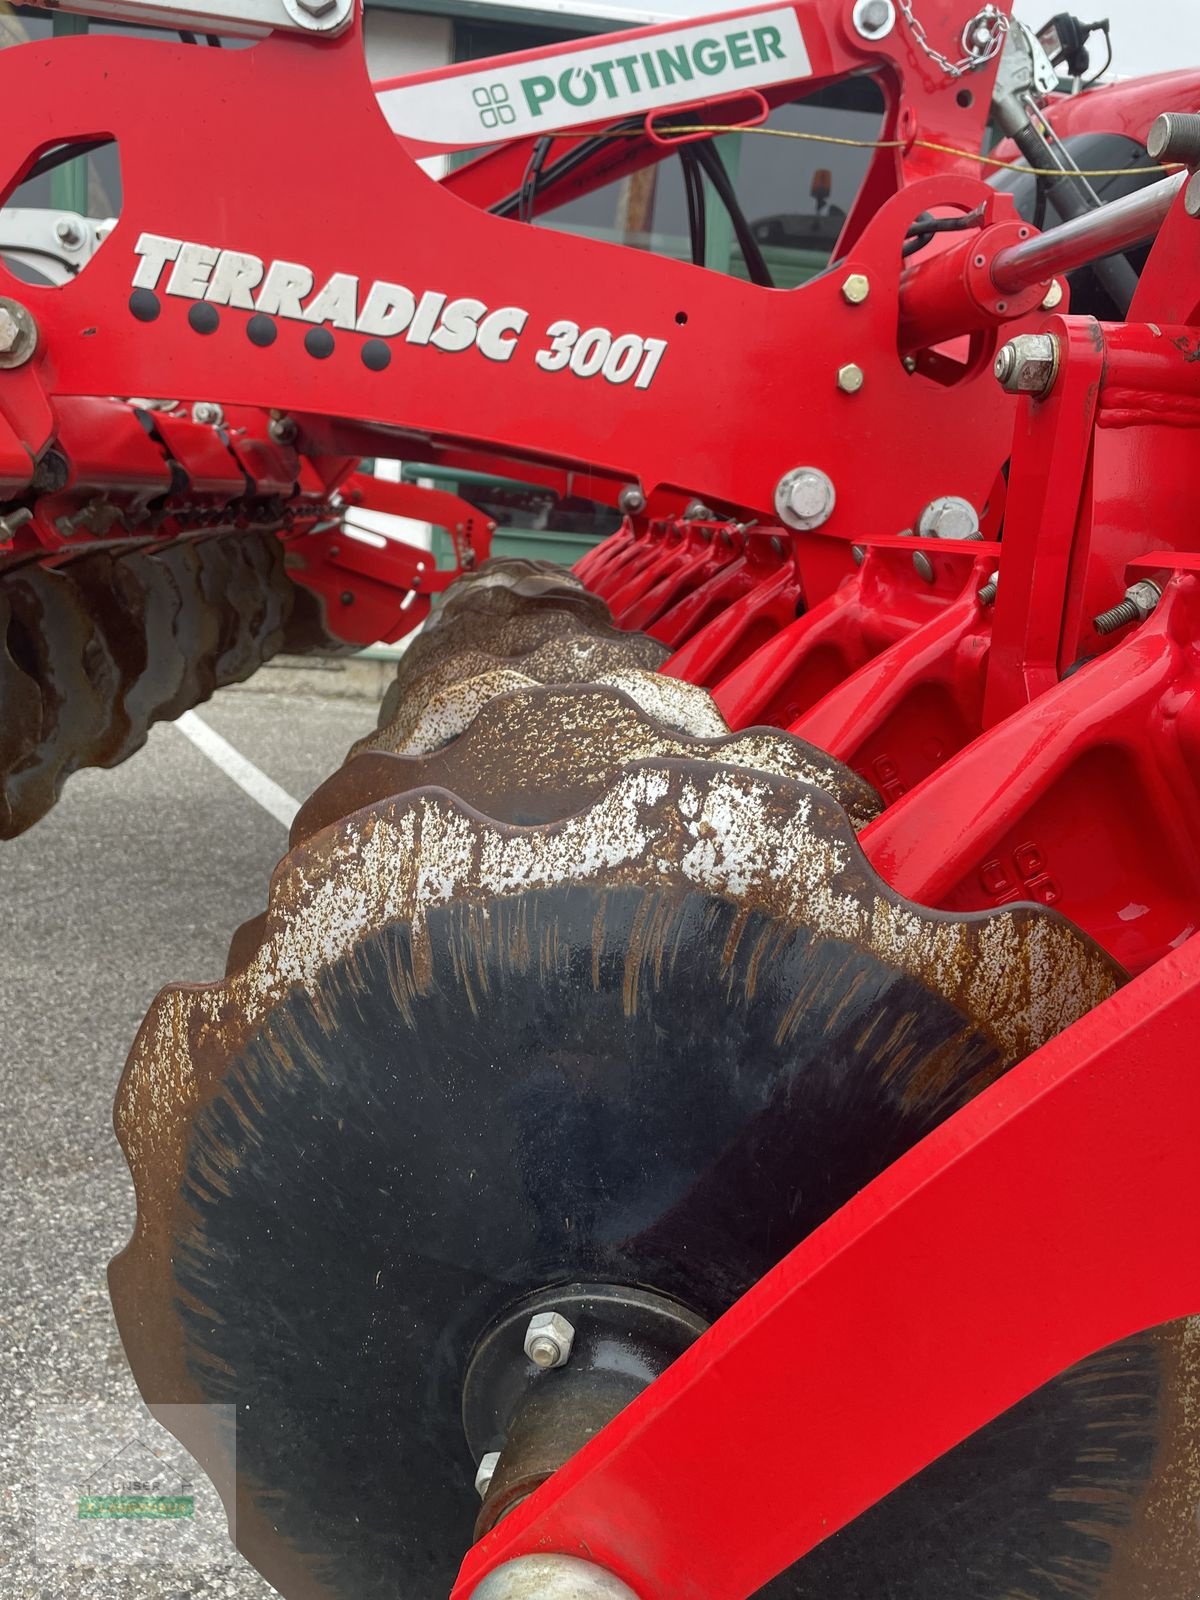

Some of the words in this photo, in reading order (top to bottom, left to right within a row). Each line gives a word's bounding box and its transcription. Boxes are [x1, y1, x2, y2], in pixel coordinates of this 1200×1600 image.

[520, 25, 787, 117] PÖTTINGER
[131, 232, 529, 362] TERRADISC
[535, 319, 668, 390] 3001
